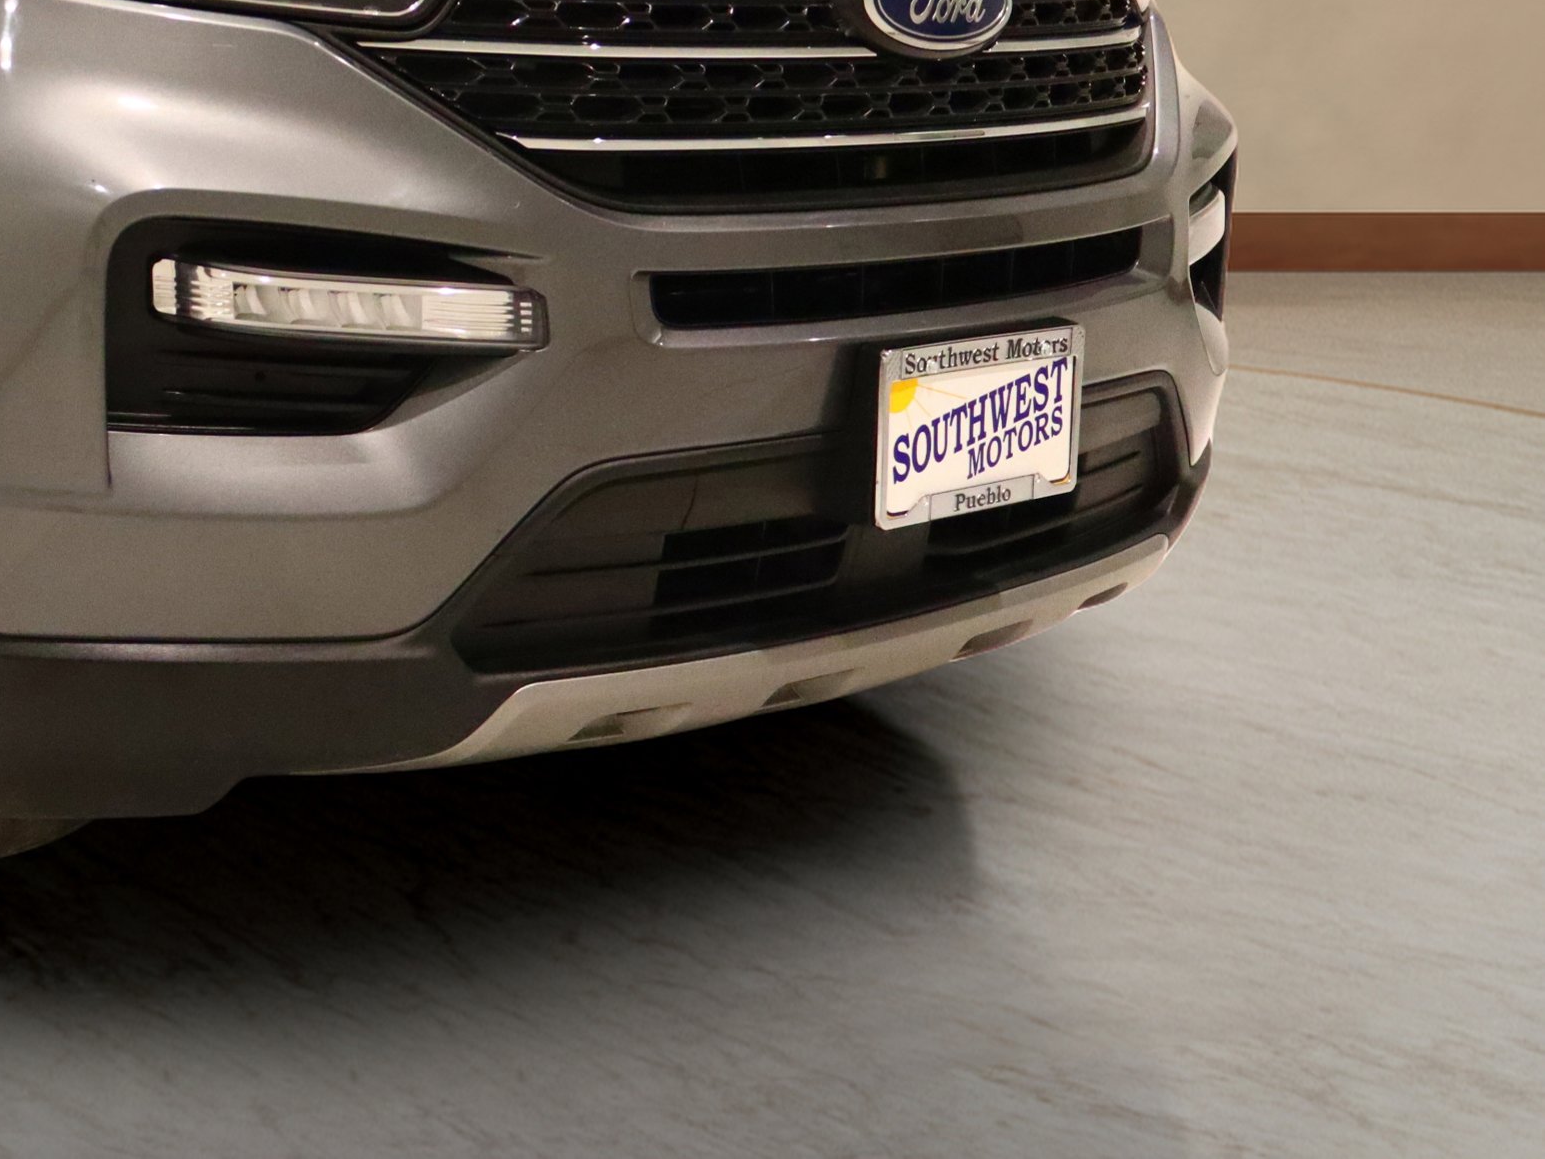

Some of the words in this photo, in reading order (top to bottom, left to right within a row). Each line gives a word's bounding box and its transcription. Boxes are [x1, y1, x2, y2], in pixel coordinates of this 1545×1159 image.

[892, 357, 1068, 485] SOUTHWEST
[966, 405, 1064, 480] MOTORS
[953, 486, 1012, 512] Pueblo
